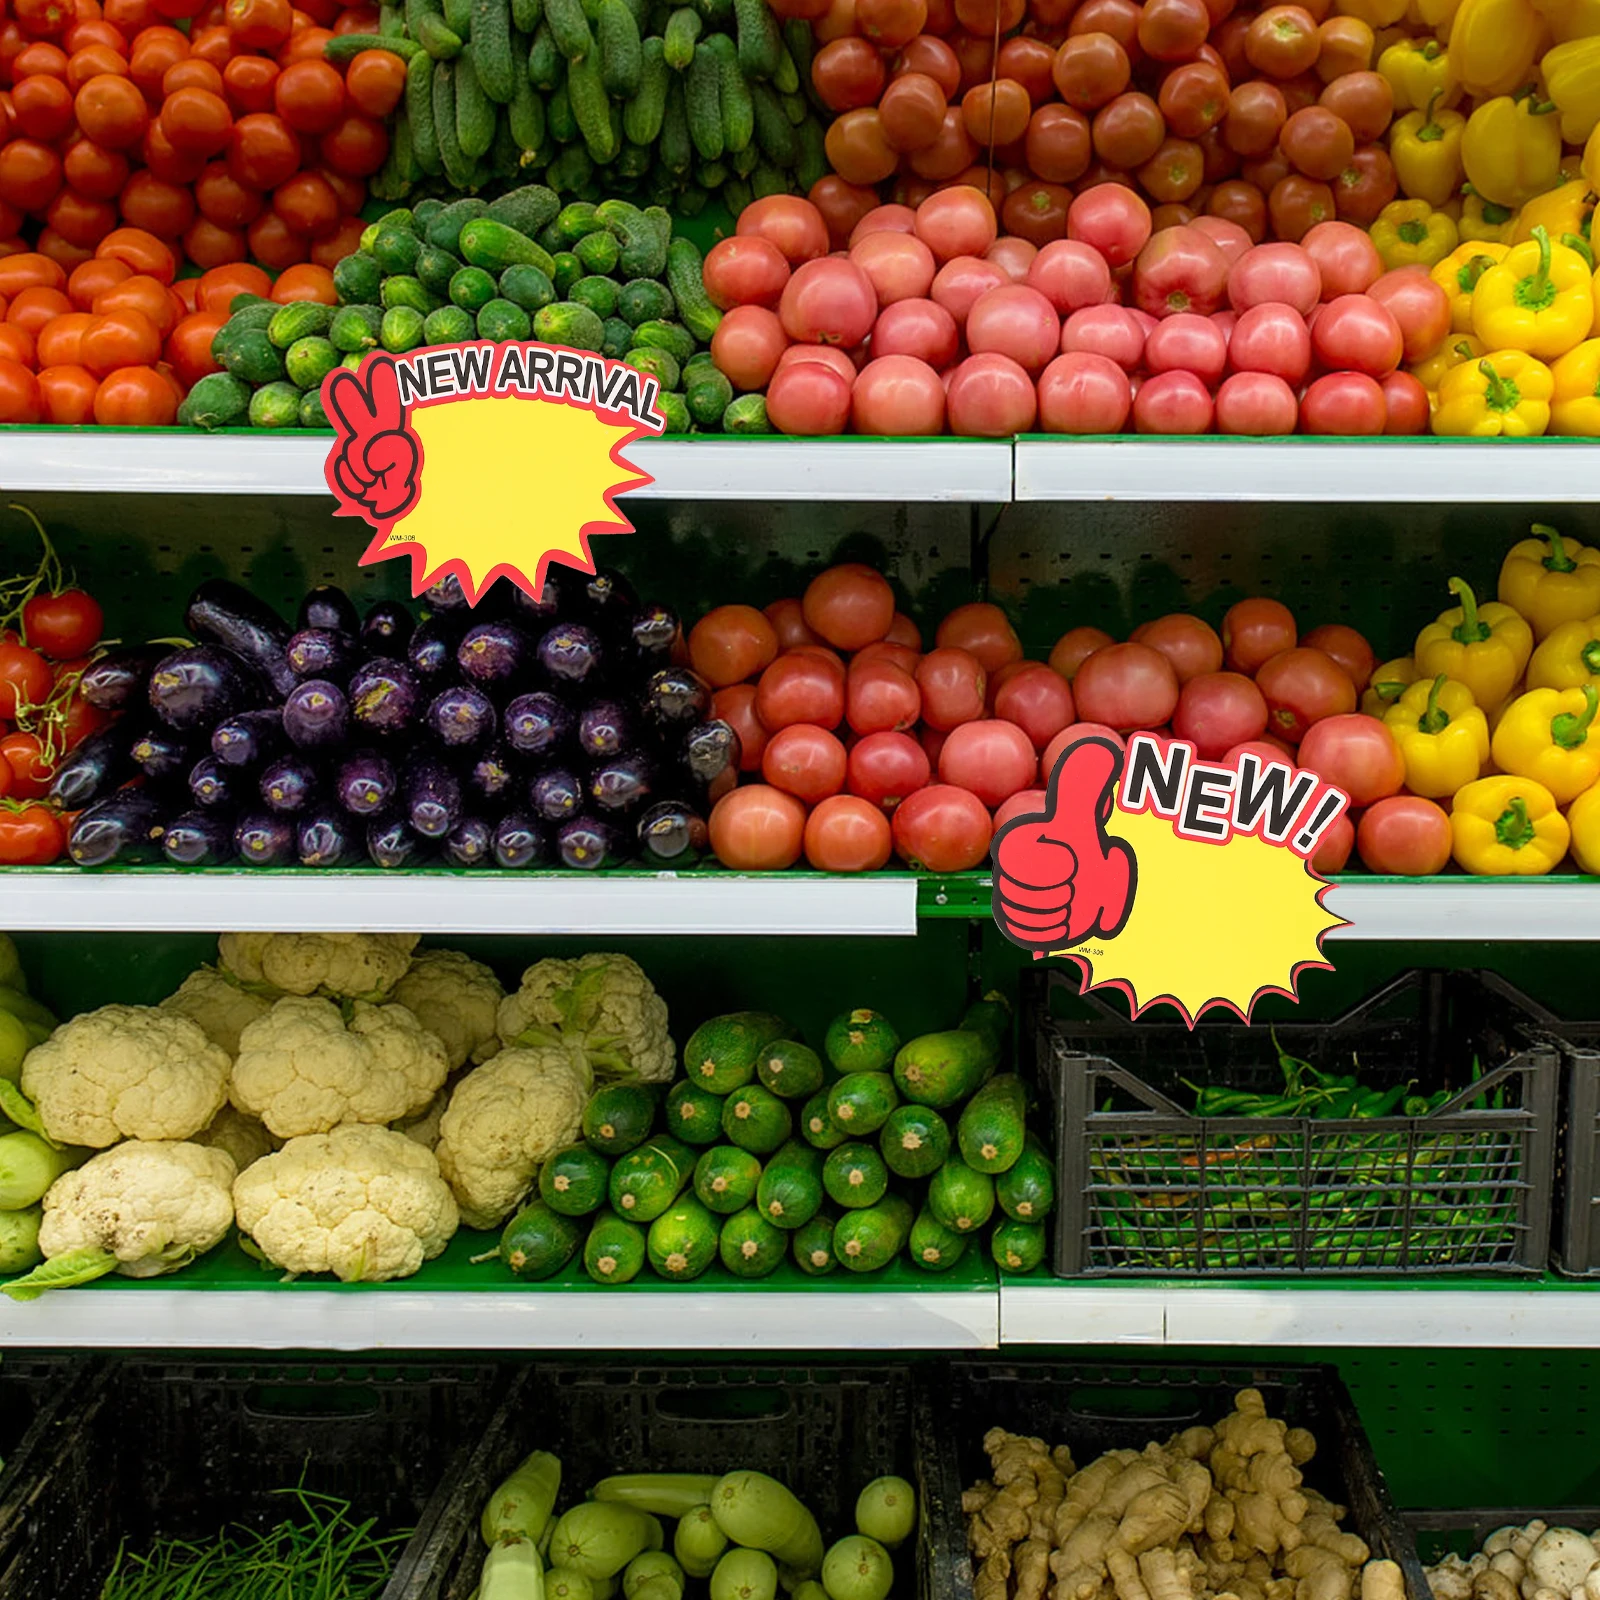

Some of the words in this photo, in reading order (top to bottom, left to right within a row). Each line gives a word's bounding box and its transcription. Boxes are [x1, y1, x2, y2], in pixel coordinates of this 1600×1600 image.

[397, 349, 491, 402] NEW
[497, 349, 662, 428] ARRIVAL
[1127, 741, 1341, 849] NEW!
